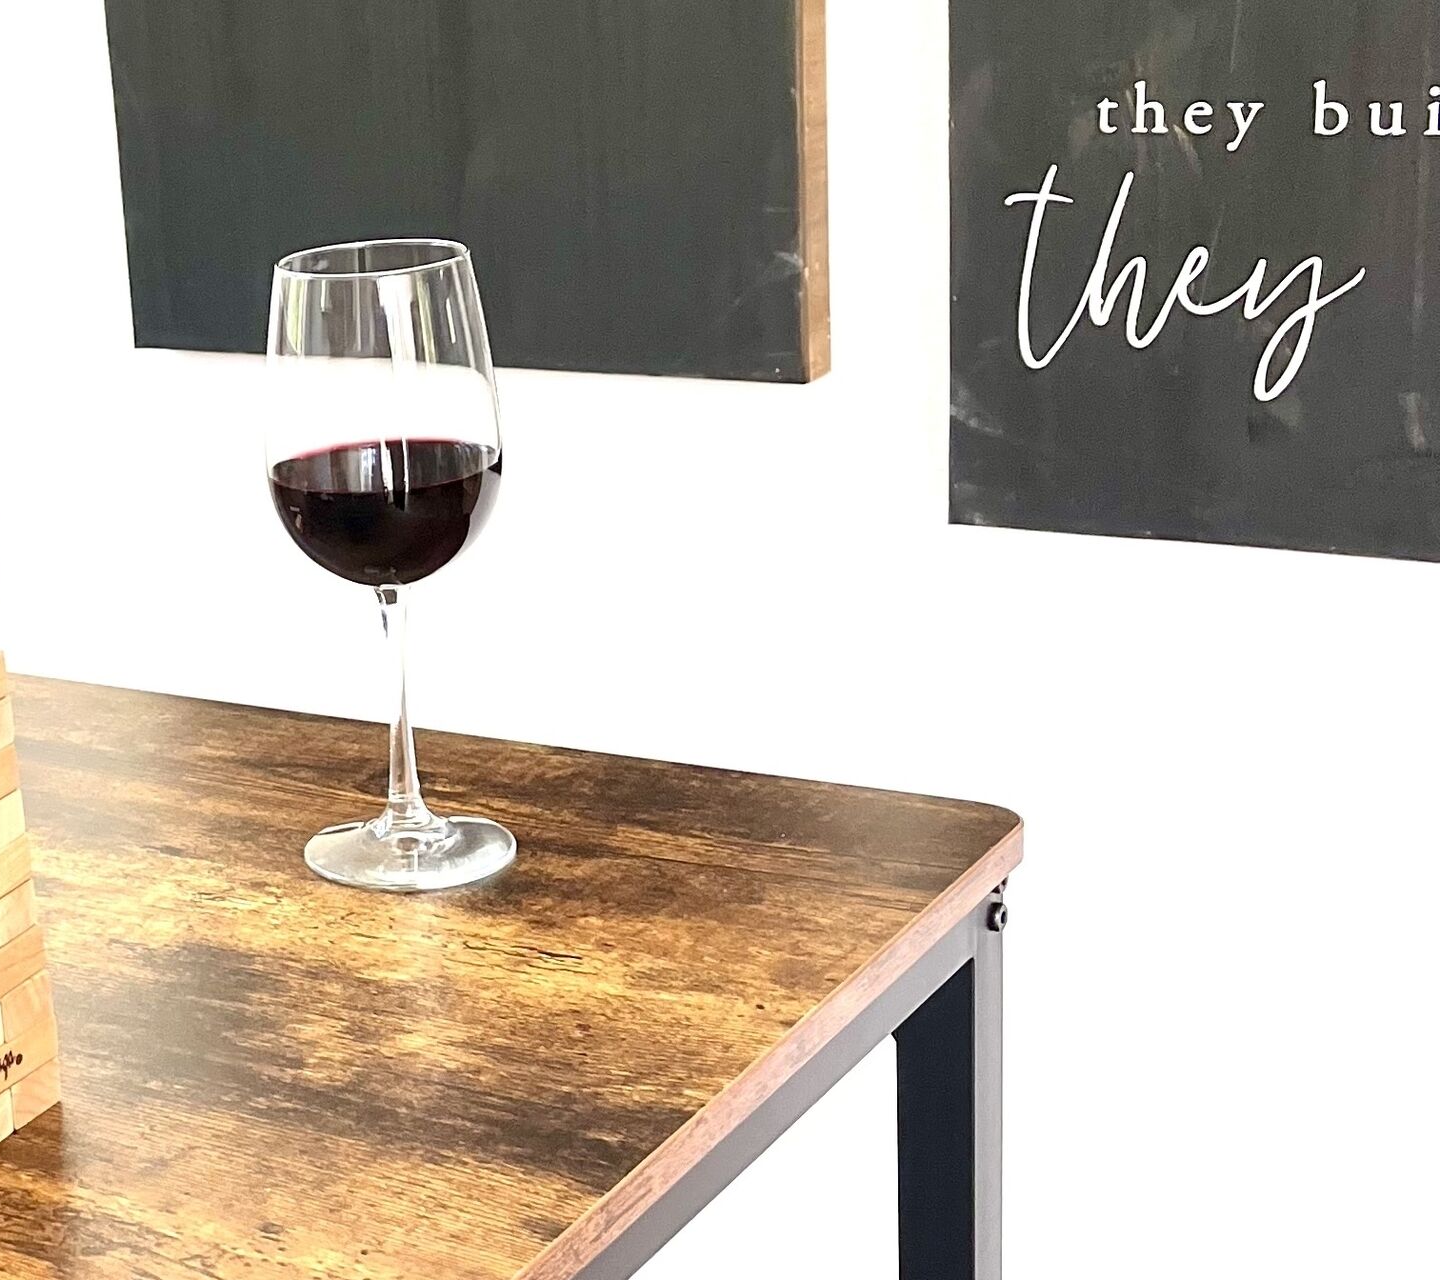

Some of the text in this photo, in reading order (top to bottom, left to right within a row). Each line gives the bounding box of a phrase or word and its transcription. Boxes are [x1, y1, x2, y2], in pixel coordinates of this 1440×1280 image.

[1097, 80, 1440, 151] they bui
[1004, 164, 1365, 401] they
